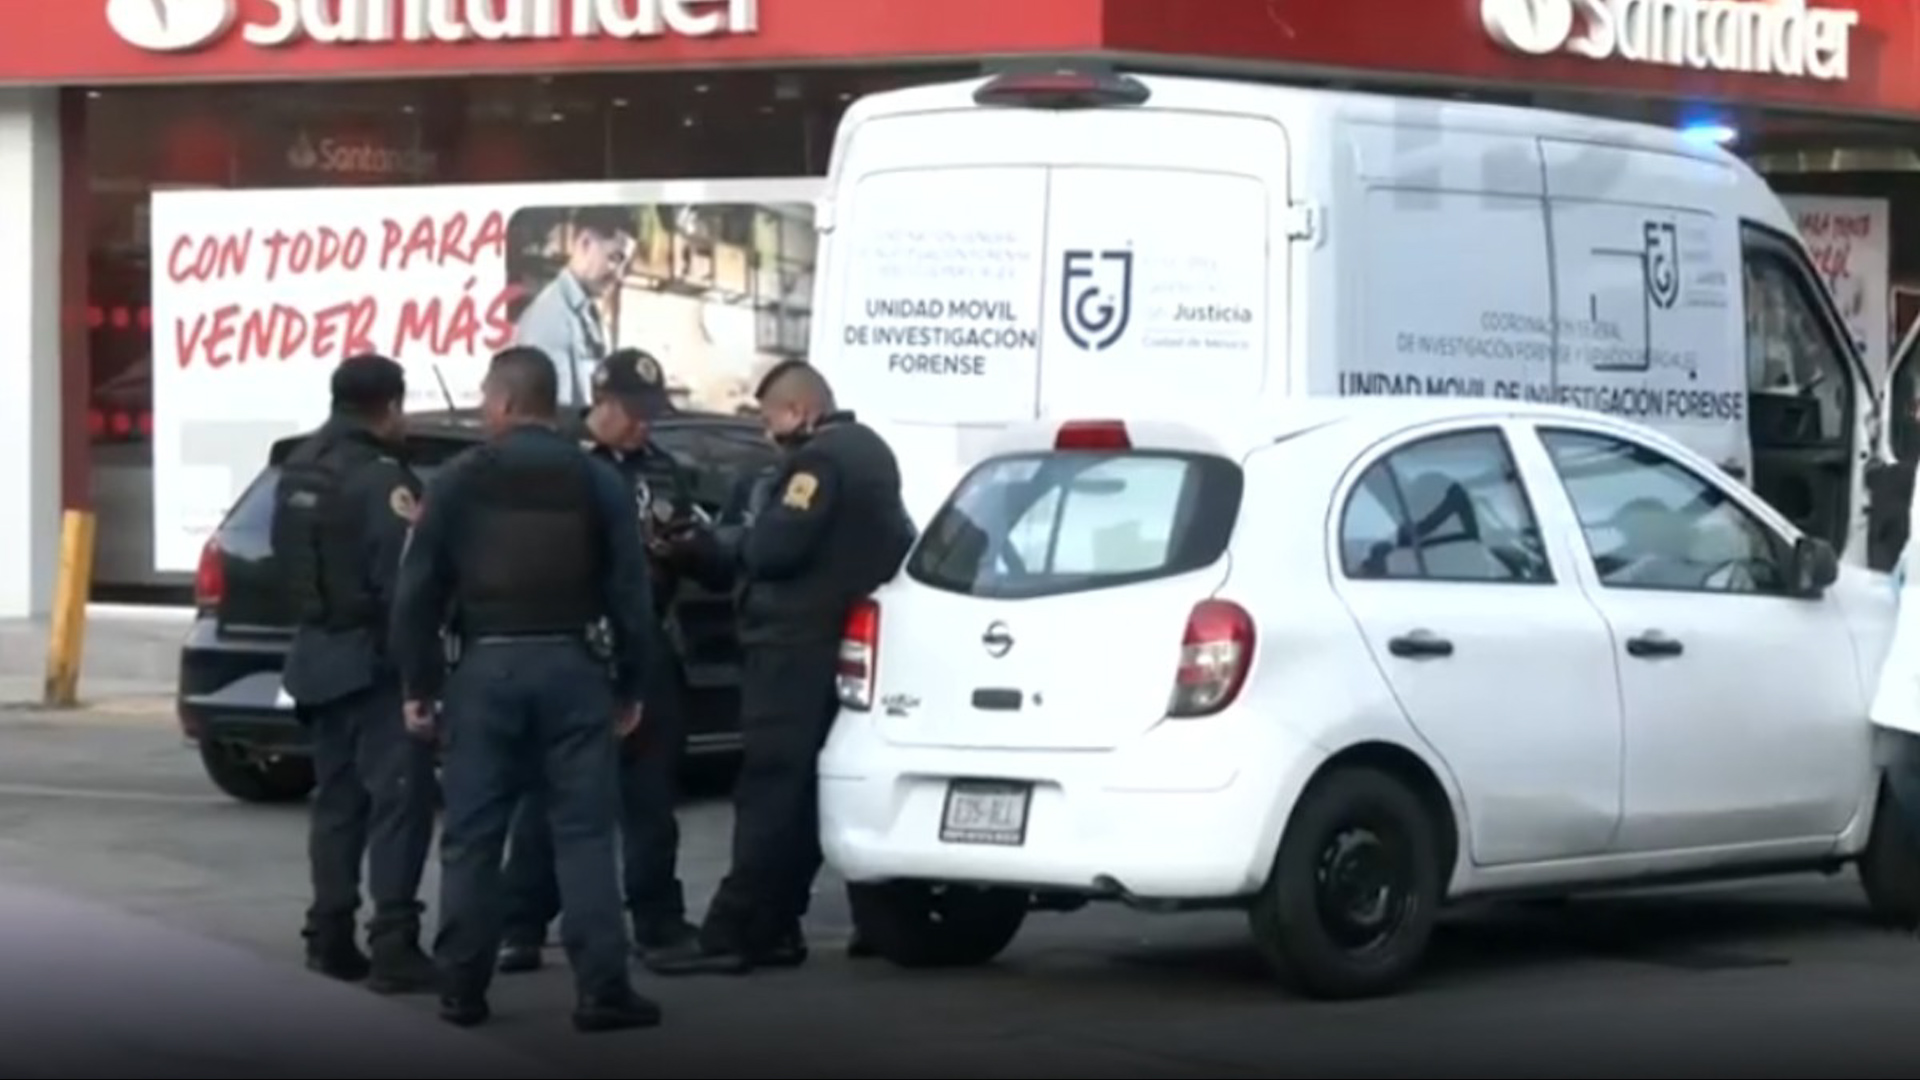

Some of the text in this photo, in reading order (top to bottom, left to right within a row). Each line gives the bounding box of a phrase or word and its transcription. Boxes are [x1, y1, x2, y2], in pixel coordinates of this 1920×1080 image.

[1567, 0, 1859, 79] Santander
[168, 228, 252, 284] CON
[379, 210, 507, 270] PARA
[175, 275, 528, 370] VENDER MÁS
[865, 298, 943, 320] UNIDAD
[1173, 303, 1253, 323] Justicia
[844, 324, 869, 346] DE
[888, 353, 986, 376] FORENSE
[1339, 371, 1423, 397] UNIDAD
[1665, 387, 1744, 420] FORENSE
